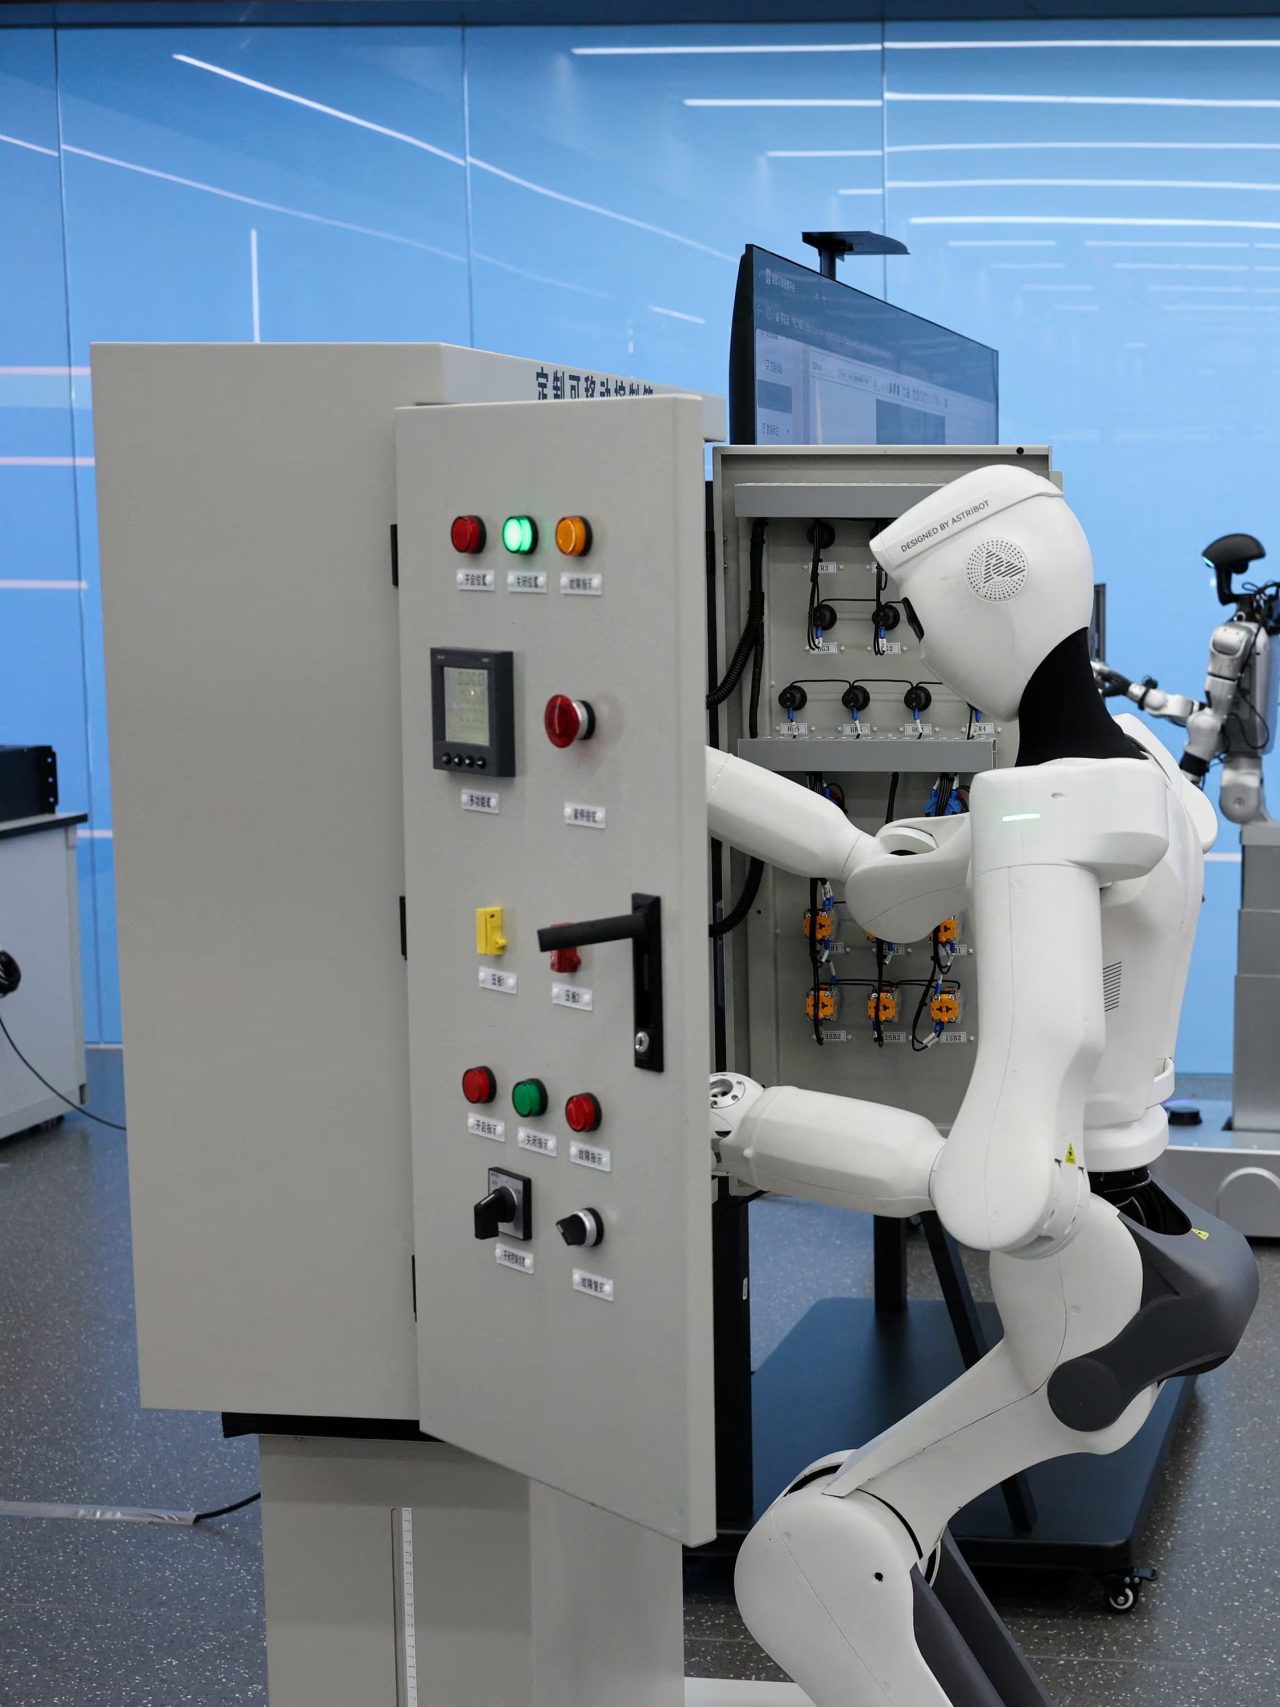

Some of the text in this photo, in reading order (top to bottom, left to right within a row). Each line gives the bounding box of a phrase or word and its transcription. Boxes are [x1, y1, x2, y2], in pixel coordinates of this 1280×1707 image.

[900, 499, 990, 553] DESIGNED BY ASTRIBOT
